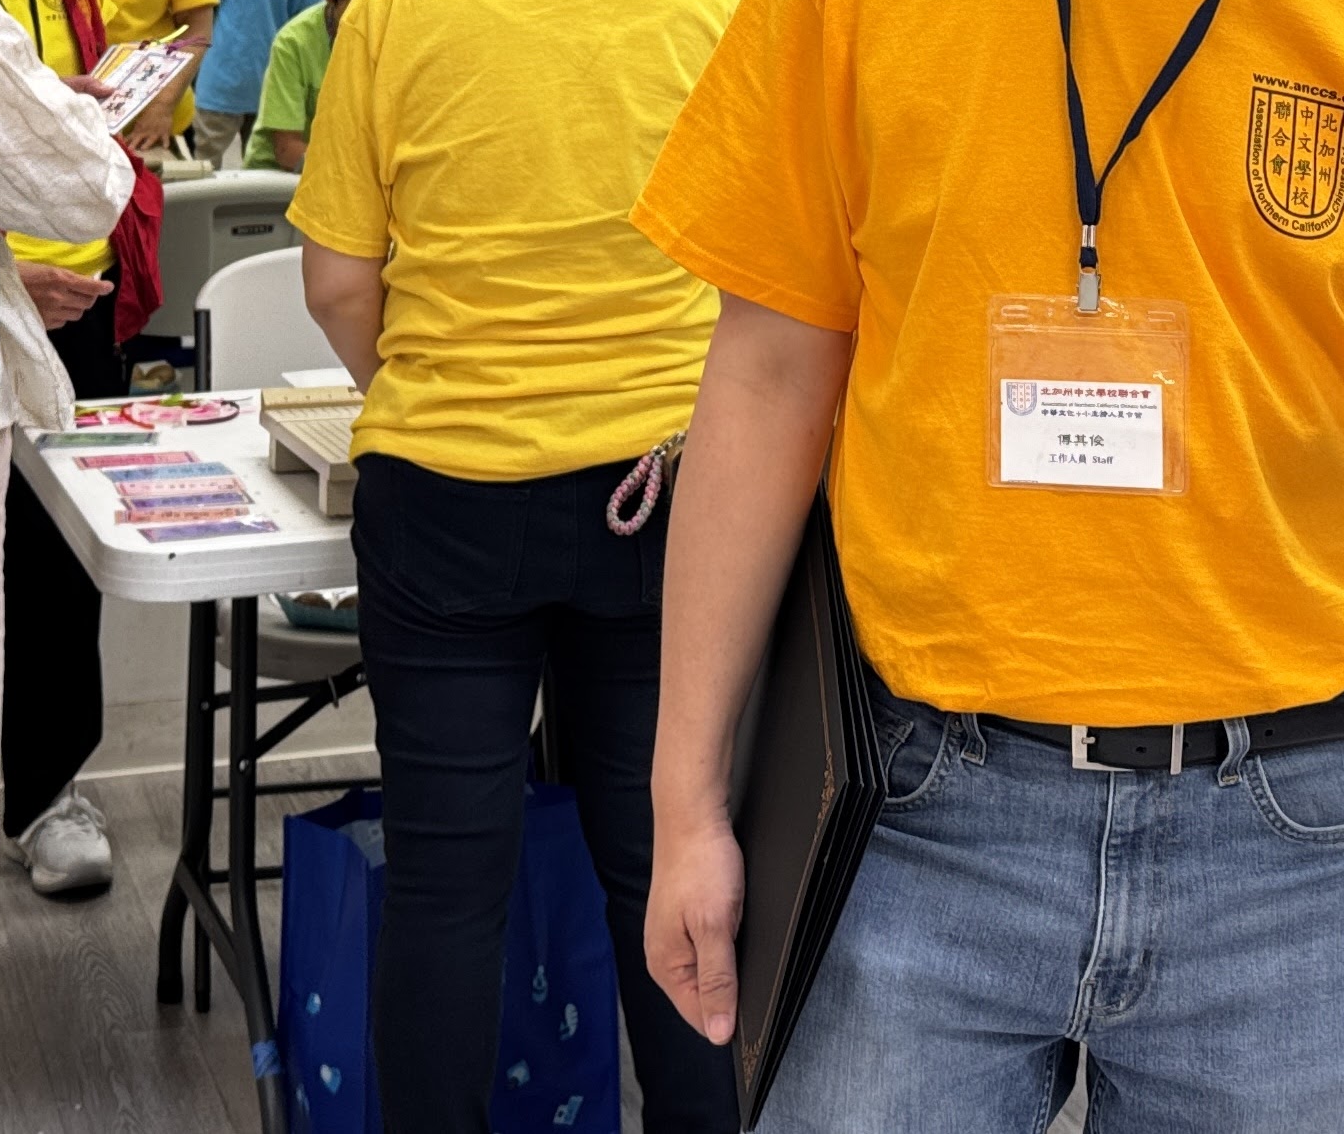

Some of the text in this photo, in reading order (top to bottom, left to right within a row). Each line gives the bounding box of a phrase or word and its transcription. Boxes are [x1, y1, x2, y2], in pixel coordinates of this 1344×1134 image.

[1252, 98, 1267, 166] Association
[1269, 100, 1292, 177] 聯合會
[1290, 105, 1314, 208] 中文學校
[1318, 112, 1338, 187] 北加州
[1252, 169, 1263, 181] of
[1254, 182, 1290, 227] Northern
[1040, 387, 1151, 400] 北加州中文學校聯合會
[1049, 452, 1114, 465] 工作人員 Staff
